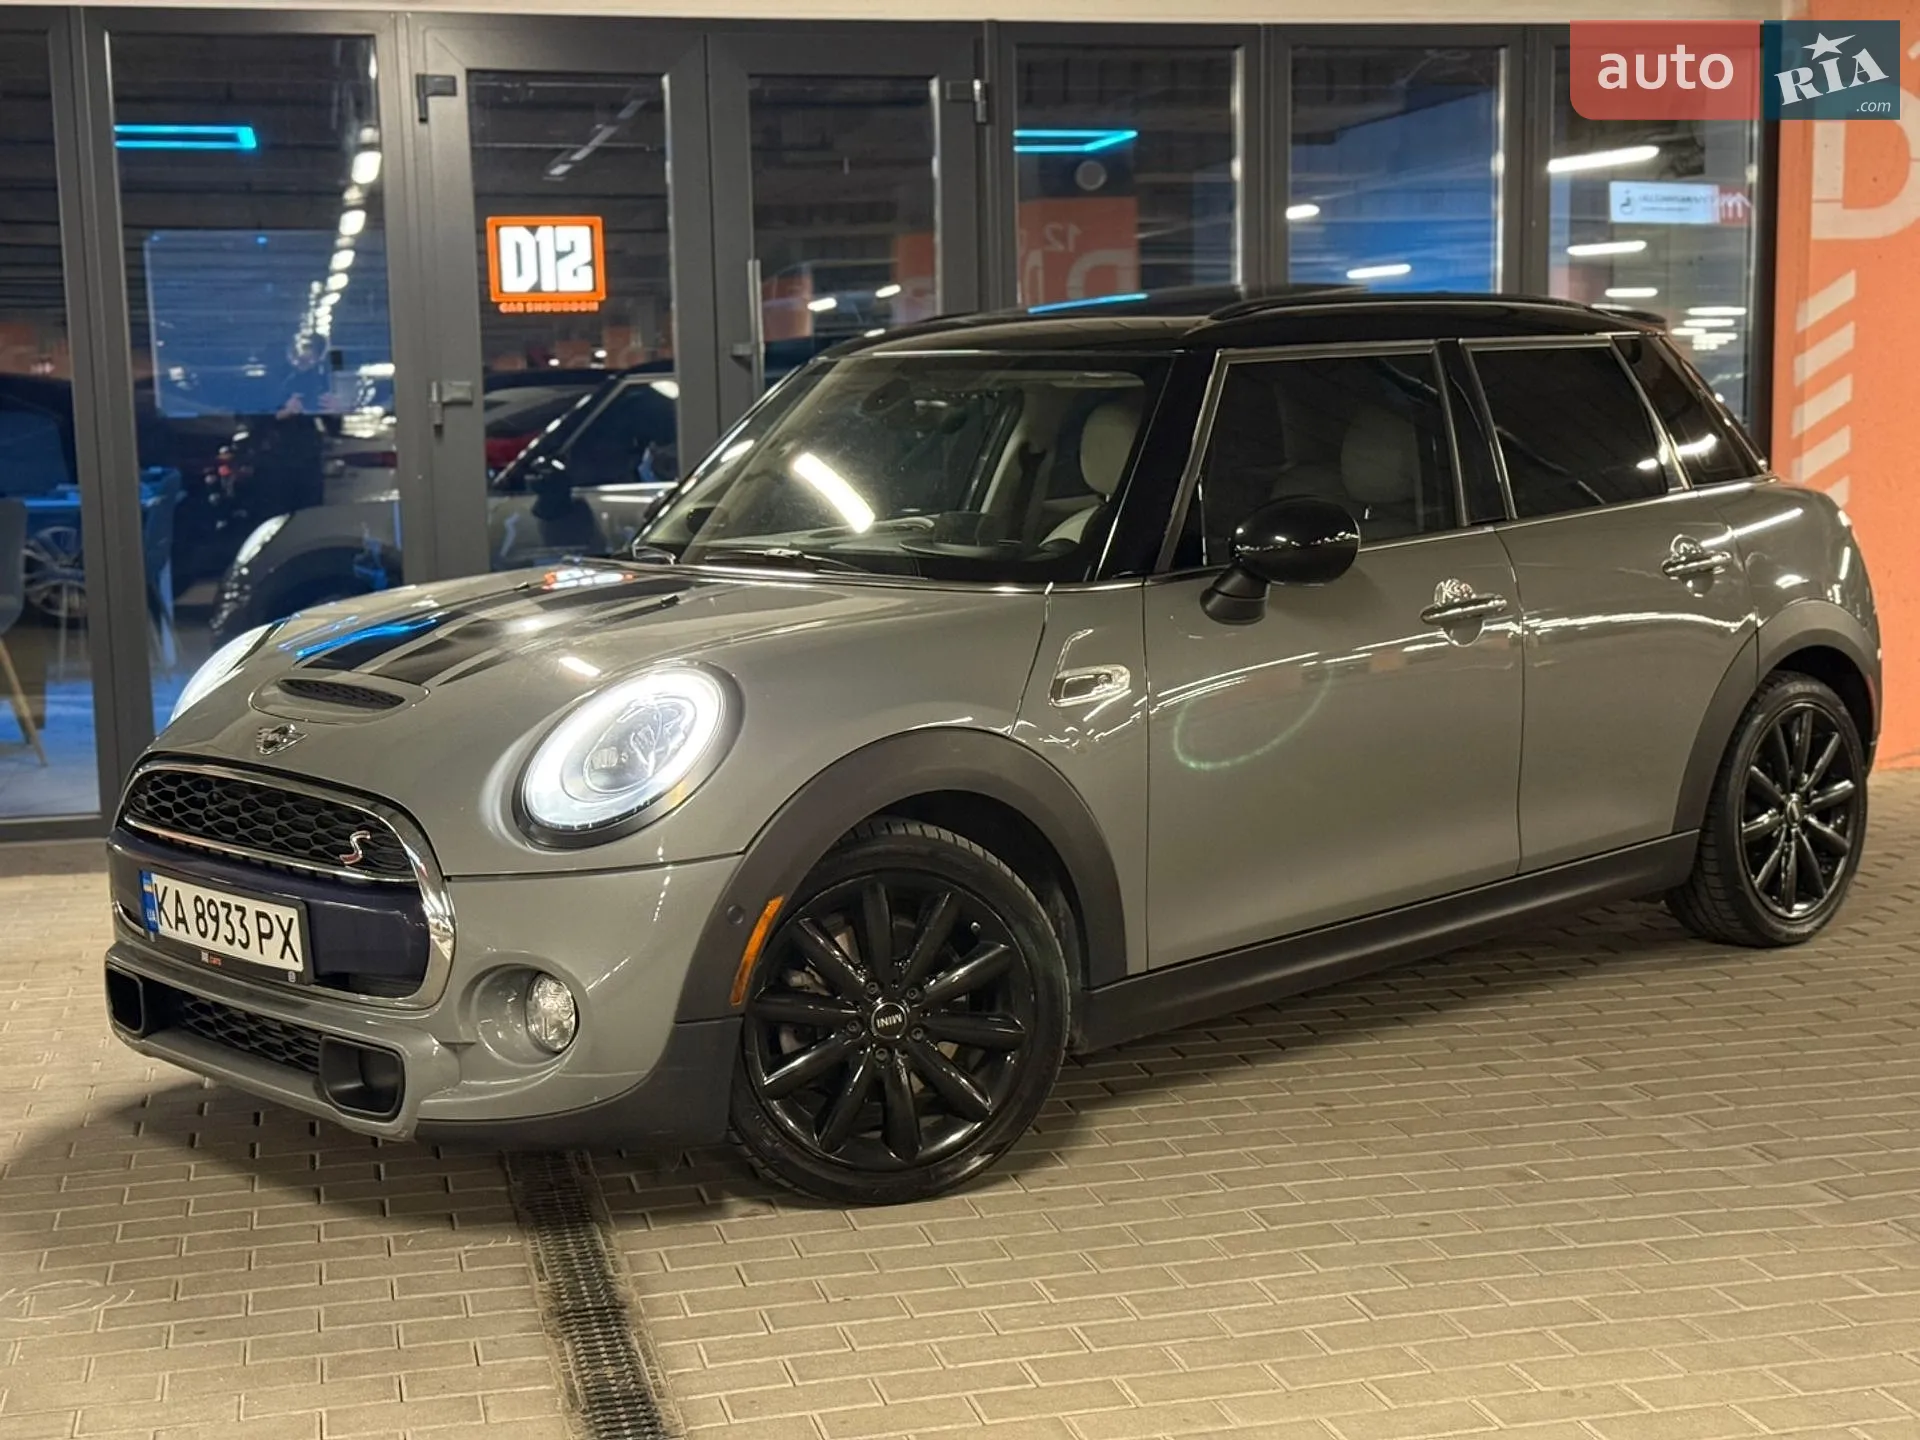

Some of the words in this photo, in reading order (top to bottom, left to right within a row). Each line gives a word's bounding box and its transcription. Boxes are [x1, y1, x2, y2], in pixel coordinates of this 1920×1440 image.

[499, 225, 594, 292] D12
[154, 883, 191, 935] KA
[193, 895, 250, 950] 8933
[255, 909, 299, 963] PX
